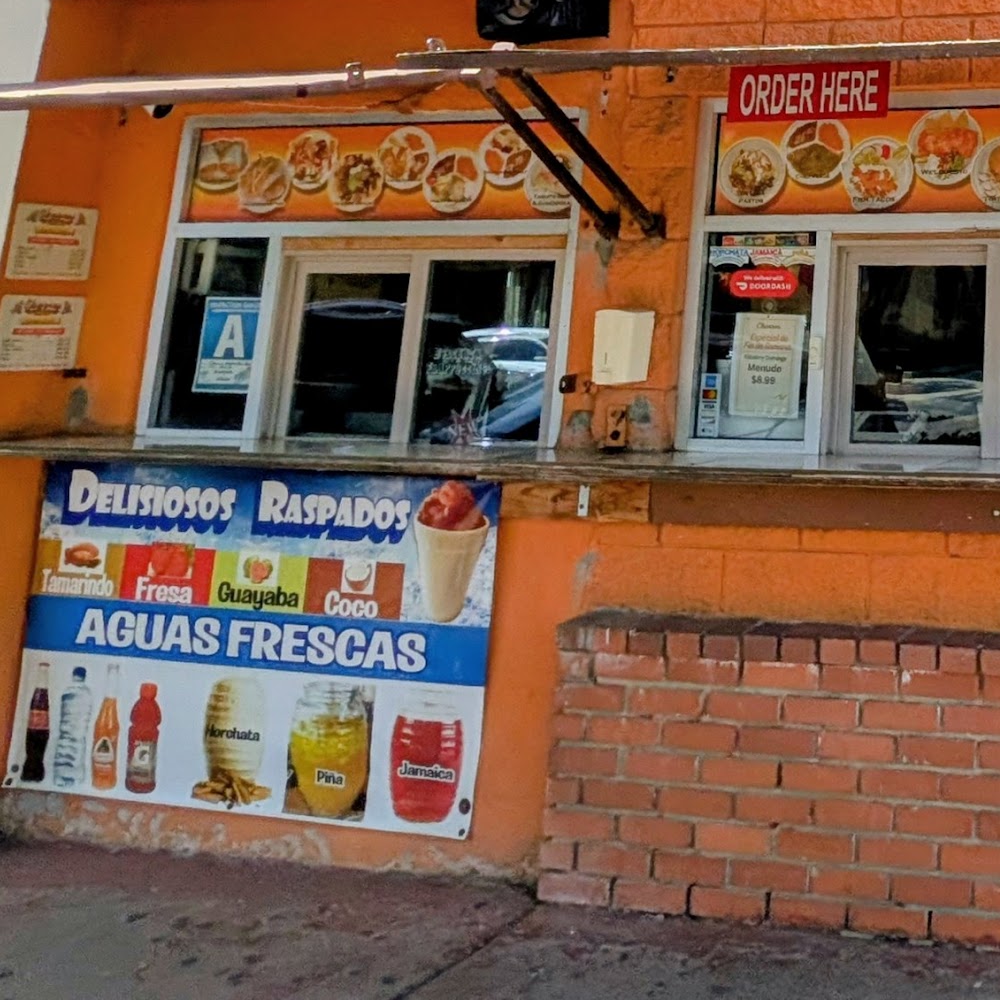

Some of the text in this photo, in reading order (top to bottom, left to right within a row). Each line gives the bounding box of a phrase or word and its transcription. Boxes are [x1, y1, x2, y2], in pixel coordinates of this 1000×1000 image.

[739, 69, 879, 116] ORDER HERE
[212, 314, 245, 358] A
[747, 363, 782, 373] Menudo
[41, 568, 114, 597] Tamarindo
[135, 576, 193, 604] Fresa
[217, 581, 299, 610] Guayaba
[323, 590, 379, 618] Coco
[75, 607, 427, 672] AGUAS FRESCAS
[206, 723, 260, 742] Horchata
[399, 762, 453, 780] Jamaica
